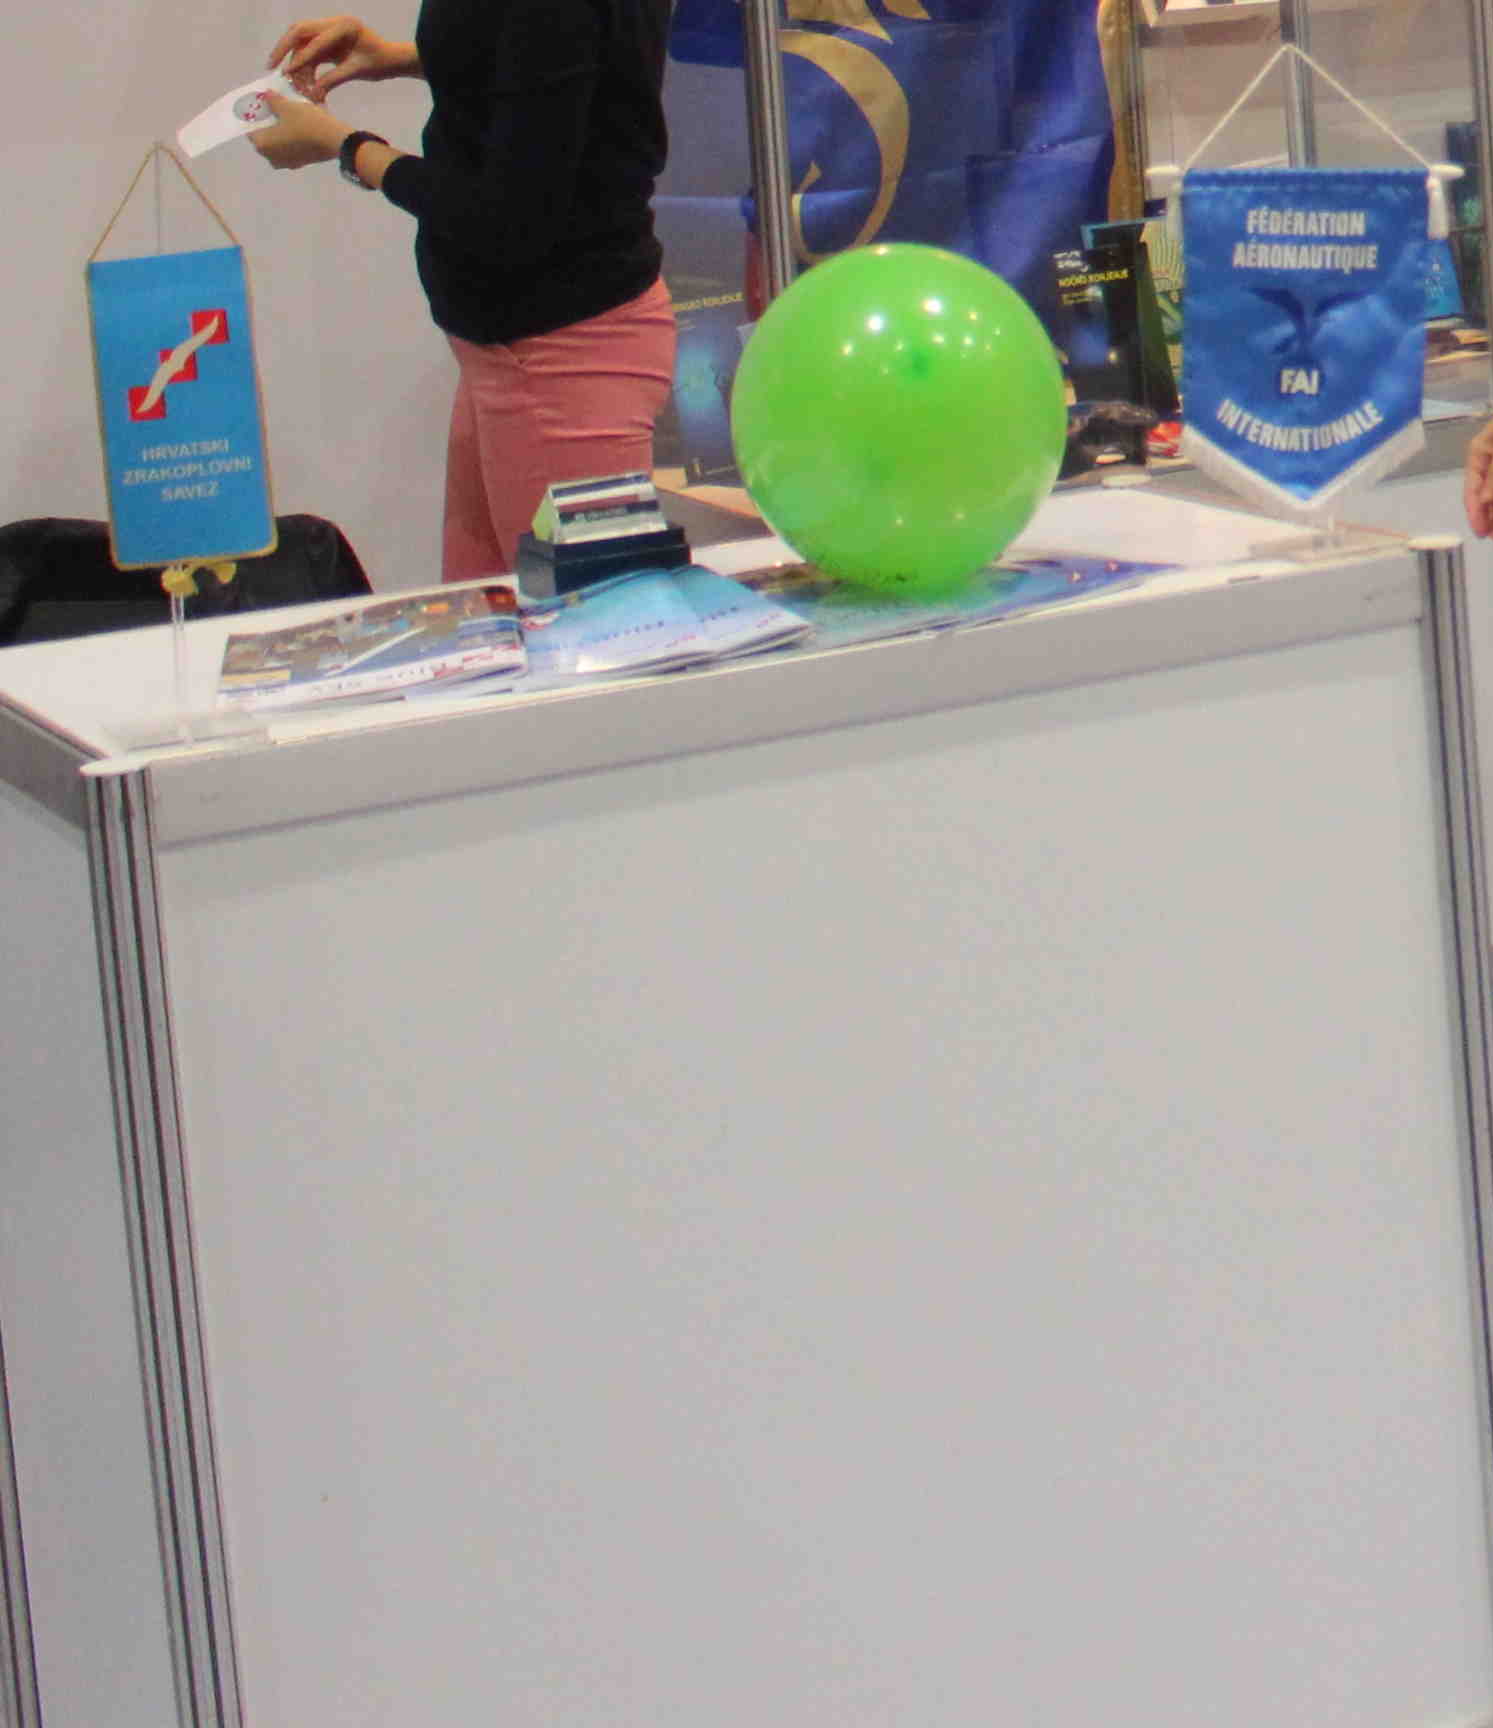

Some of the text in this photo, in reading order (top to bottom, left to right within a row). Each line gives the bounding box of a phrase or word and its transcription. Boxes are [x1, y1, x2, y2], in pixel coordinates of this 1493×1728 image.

[1246, 205, 1367, 237] FÉDÉRATION
[1232, 235, 1379, 275] AÉRONAUTIQUE
[1279, 368, 1320, 395] FAI
[1216, 398, 1385, 453] INTERNATIONALE
[141, 438, 230, 463] HRVATSKI
[122, 455, 254, 486] ZRAKOPLOVNI
[160, 481, 220, 503] SAVEZ
